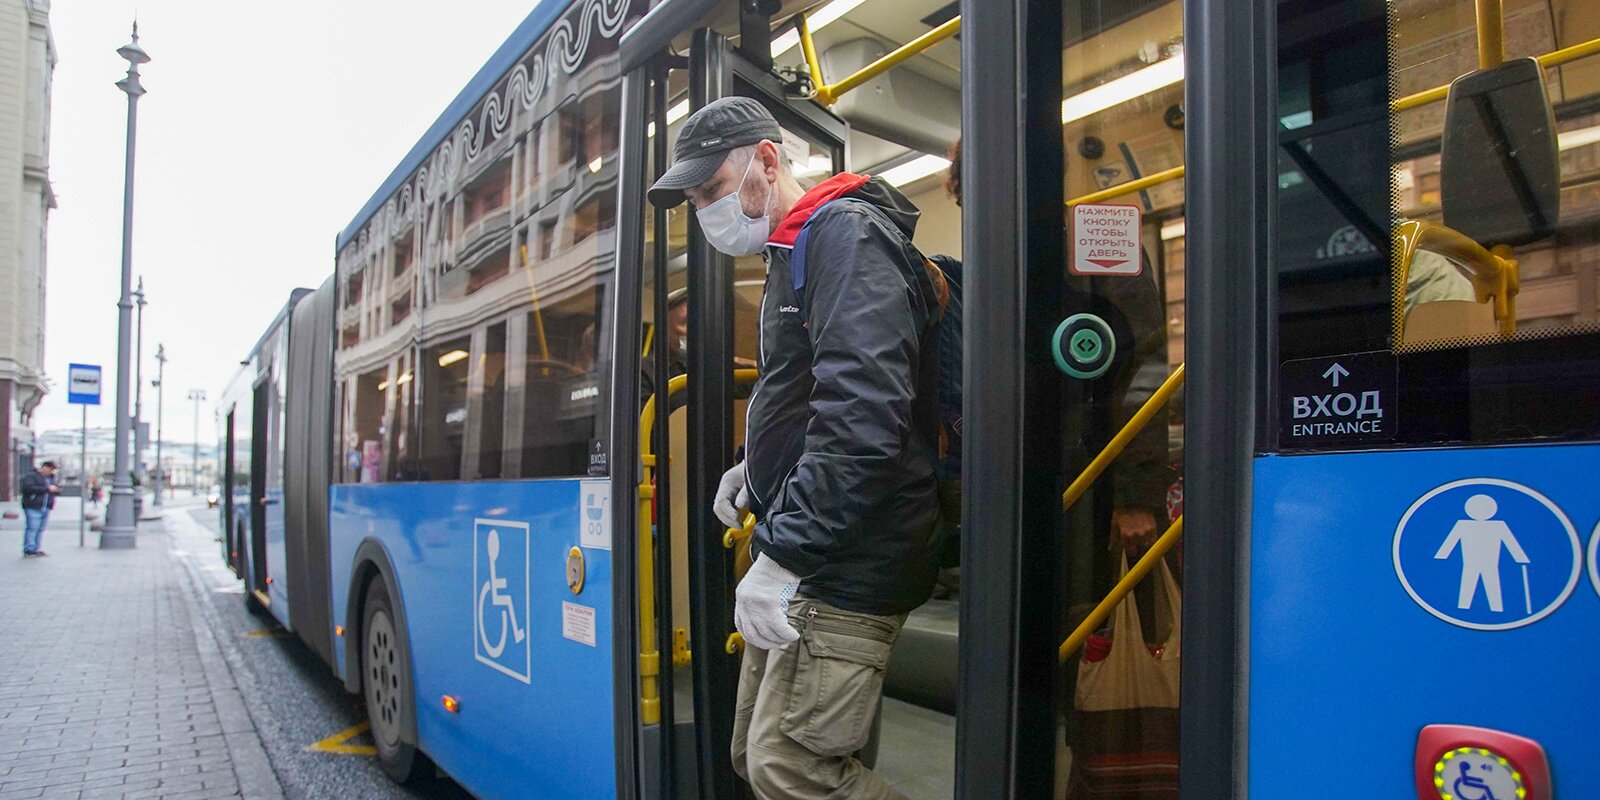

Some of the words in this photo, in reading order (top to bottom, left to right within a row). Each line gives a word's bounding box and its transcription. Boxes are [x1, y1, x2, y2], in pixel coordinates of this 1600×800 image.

[1078, 208, 1135, 217] НАЖМИТЕ
[1083, 218, 1130, 227] КНОПКУ
[1087, 228, 1127, 237] ЧТОБЫ
[1079, 238, 1135, 248] ОТКРЫТЬ
[1088, 249, 1127, 258] ДВЕРЬ
[1293, 390, 1383, 419] ВХОД
[1292, 420, 1382, 437] ENTRANCE
